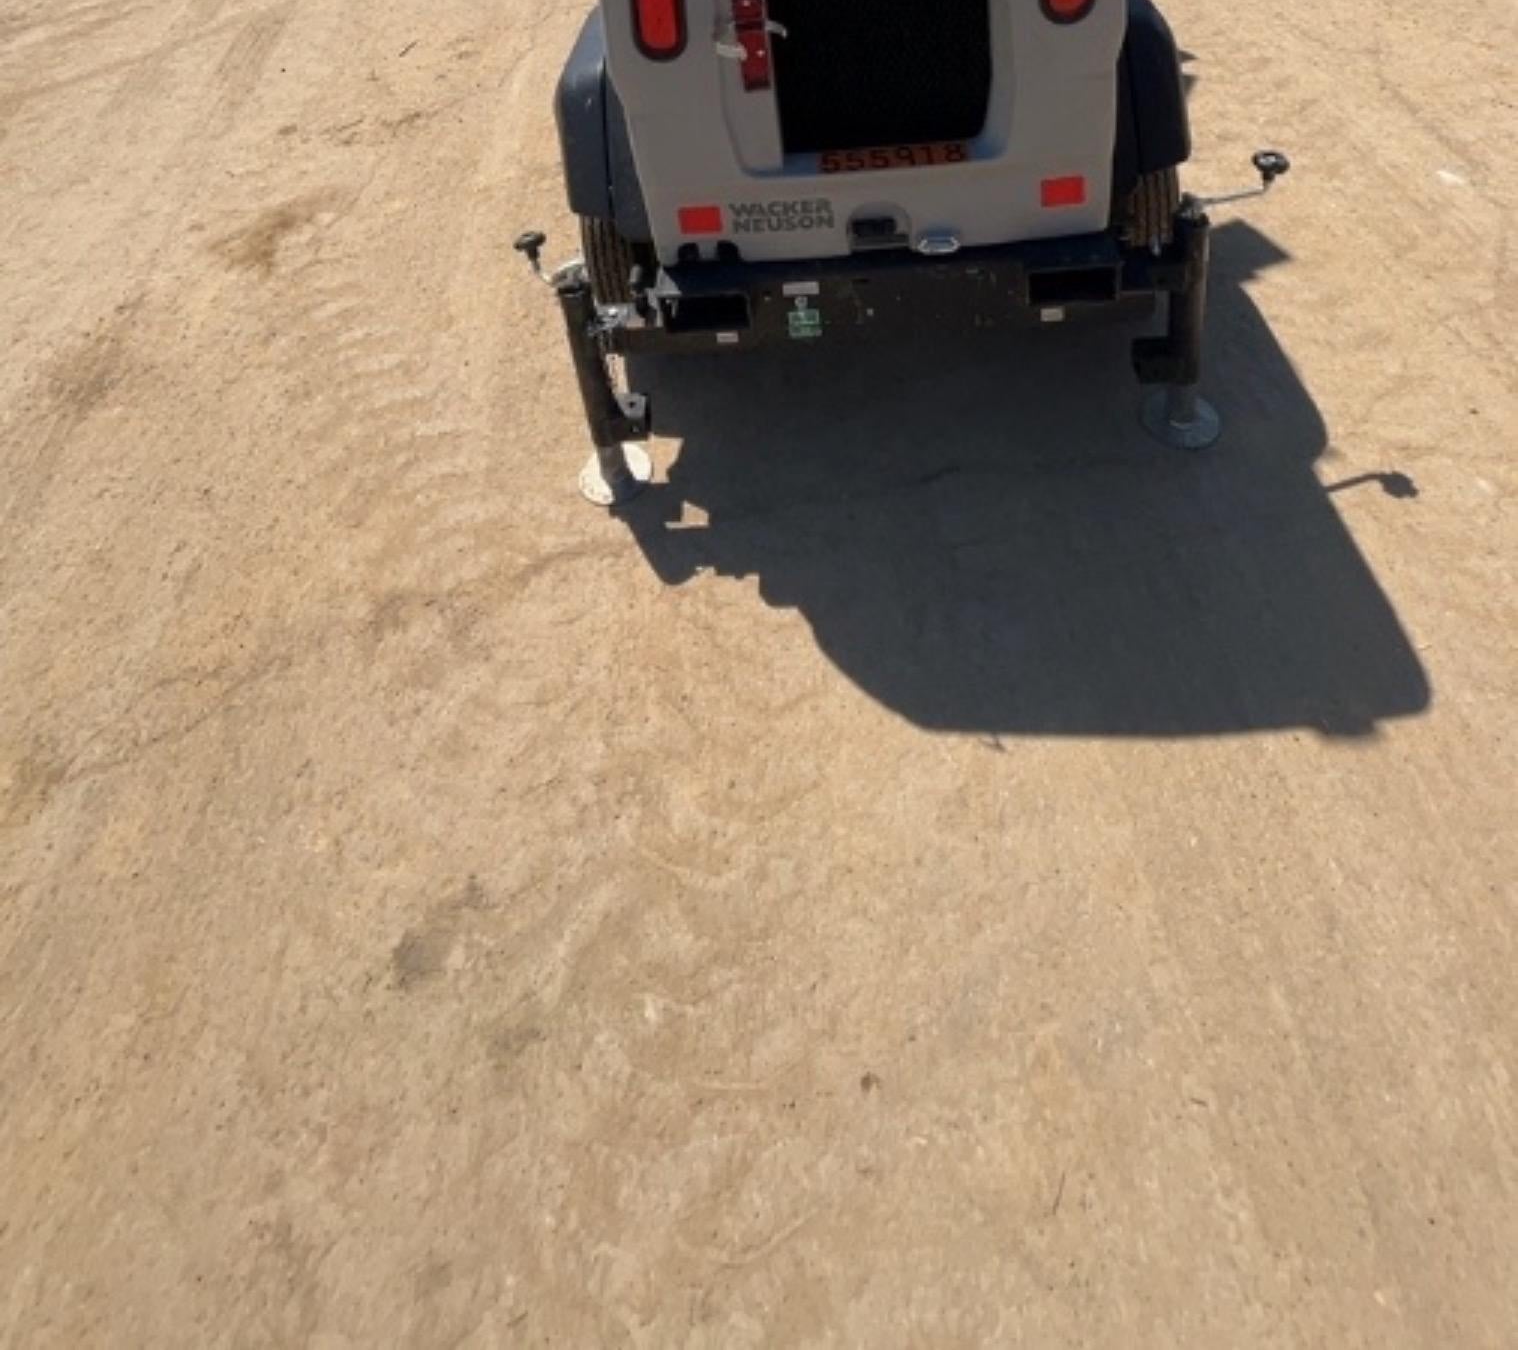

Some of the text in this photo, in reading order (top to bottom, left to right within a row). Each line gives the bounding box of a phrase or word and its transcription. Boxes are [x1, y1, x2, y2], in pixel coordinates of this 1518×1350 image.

[819, 144, 966, 173] 555918
[729, 199, 832, 218] WACKER
[732, 214, 835, 234] NEUSON
